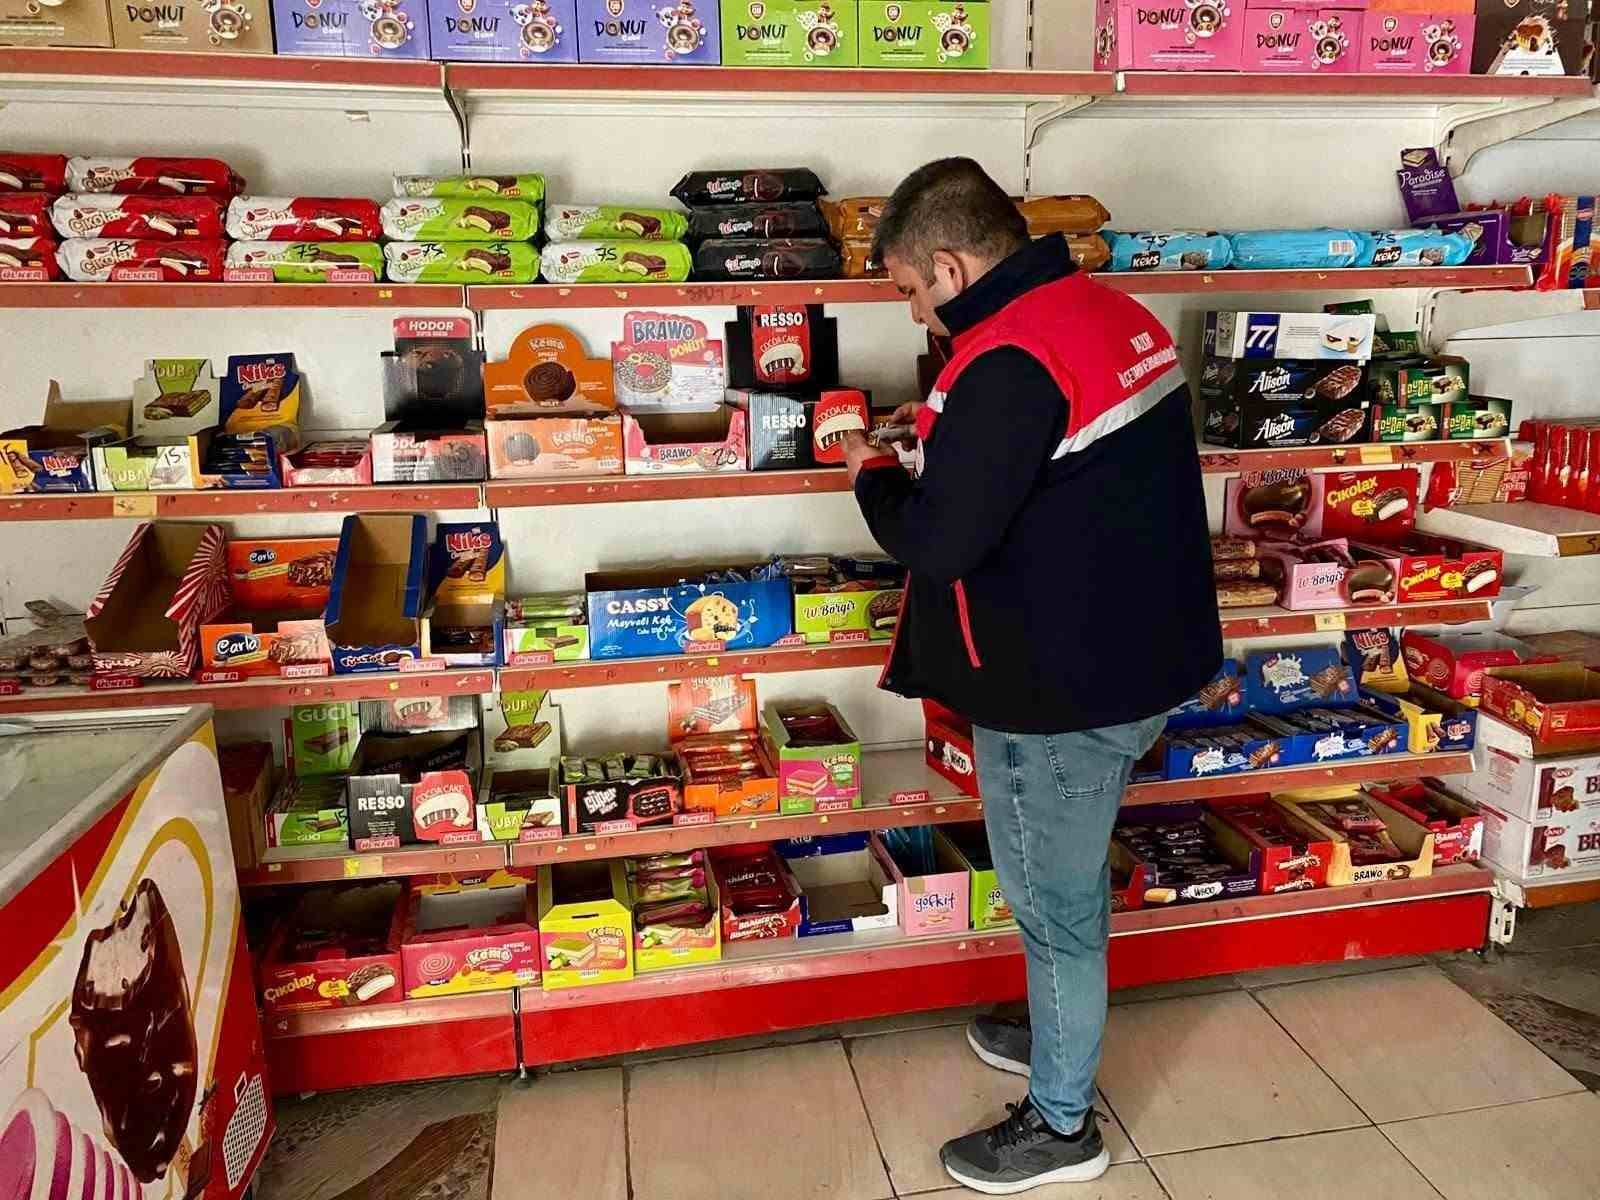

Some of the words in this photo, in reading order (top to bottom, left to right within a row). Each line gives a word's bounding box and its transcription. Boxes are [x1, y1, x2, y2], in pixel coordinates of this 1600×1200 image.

[127, 4, 186, 23] DONUT
[291, 11, 349, 29] DONUT
[1136, 8, 1187, 26] DONUT
[444, 16, 501, 33] DONUT
[594, 19, 649, 36] DONUT
[736, 24, 789, 42] DONUT
[873, 24, 923, 42] DONUT
[1256, 33, 1301, 51] DONUT
[1370, 37, 1415, 54] DONUT
[1398, 167, 1447, 189] Paradise
[595, 247, 618, 262] 75
[408, 320, 454, 331] HODOR
[760, 312, 804, 328] RESSO
[631, 318, 697, 344] BRAWO
[1245, 325, 1278, 348] 77
[668, 337, 709, 359] DONUT
[1249, 370, 1292, 394] Alison
[840, 404, 862, 416] CAKE
[762, 413, 807, 429] RESSO
[1253, 417, 1296, 442] Alison
[659, 447, 693, 461] BRAWO
[606, 597, 675, 615] CASSY
[358, 796, 406, 811] RESSO
[1353, 868, 1383, 882] BRAWO
